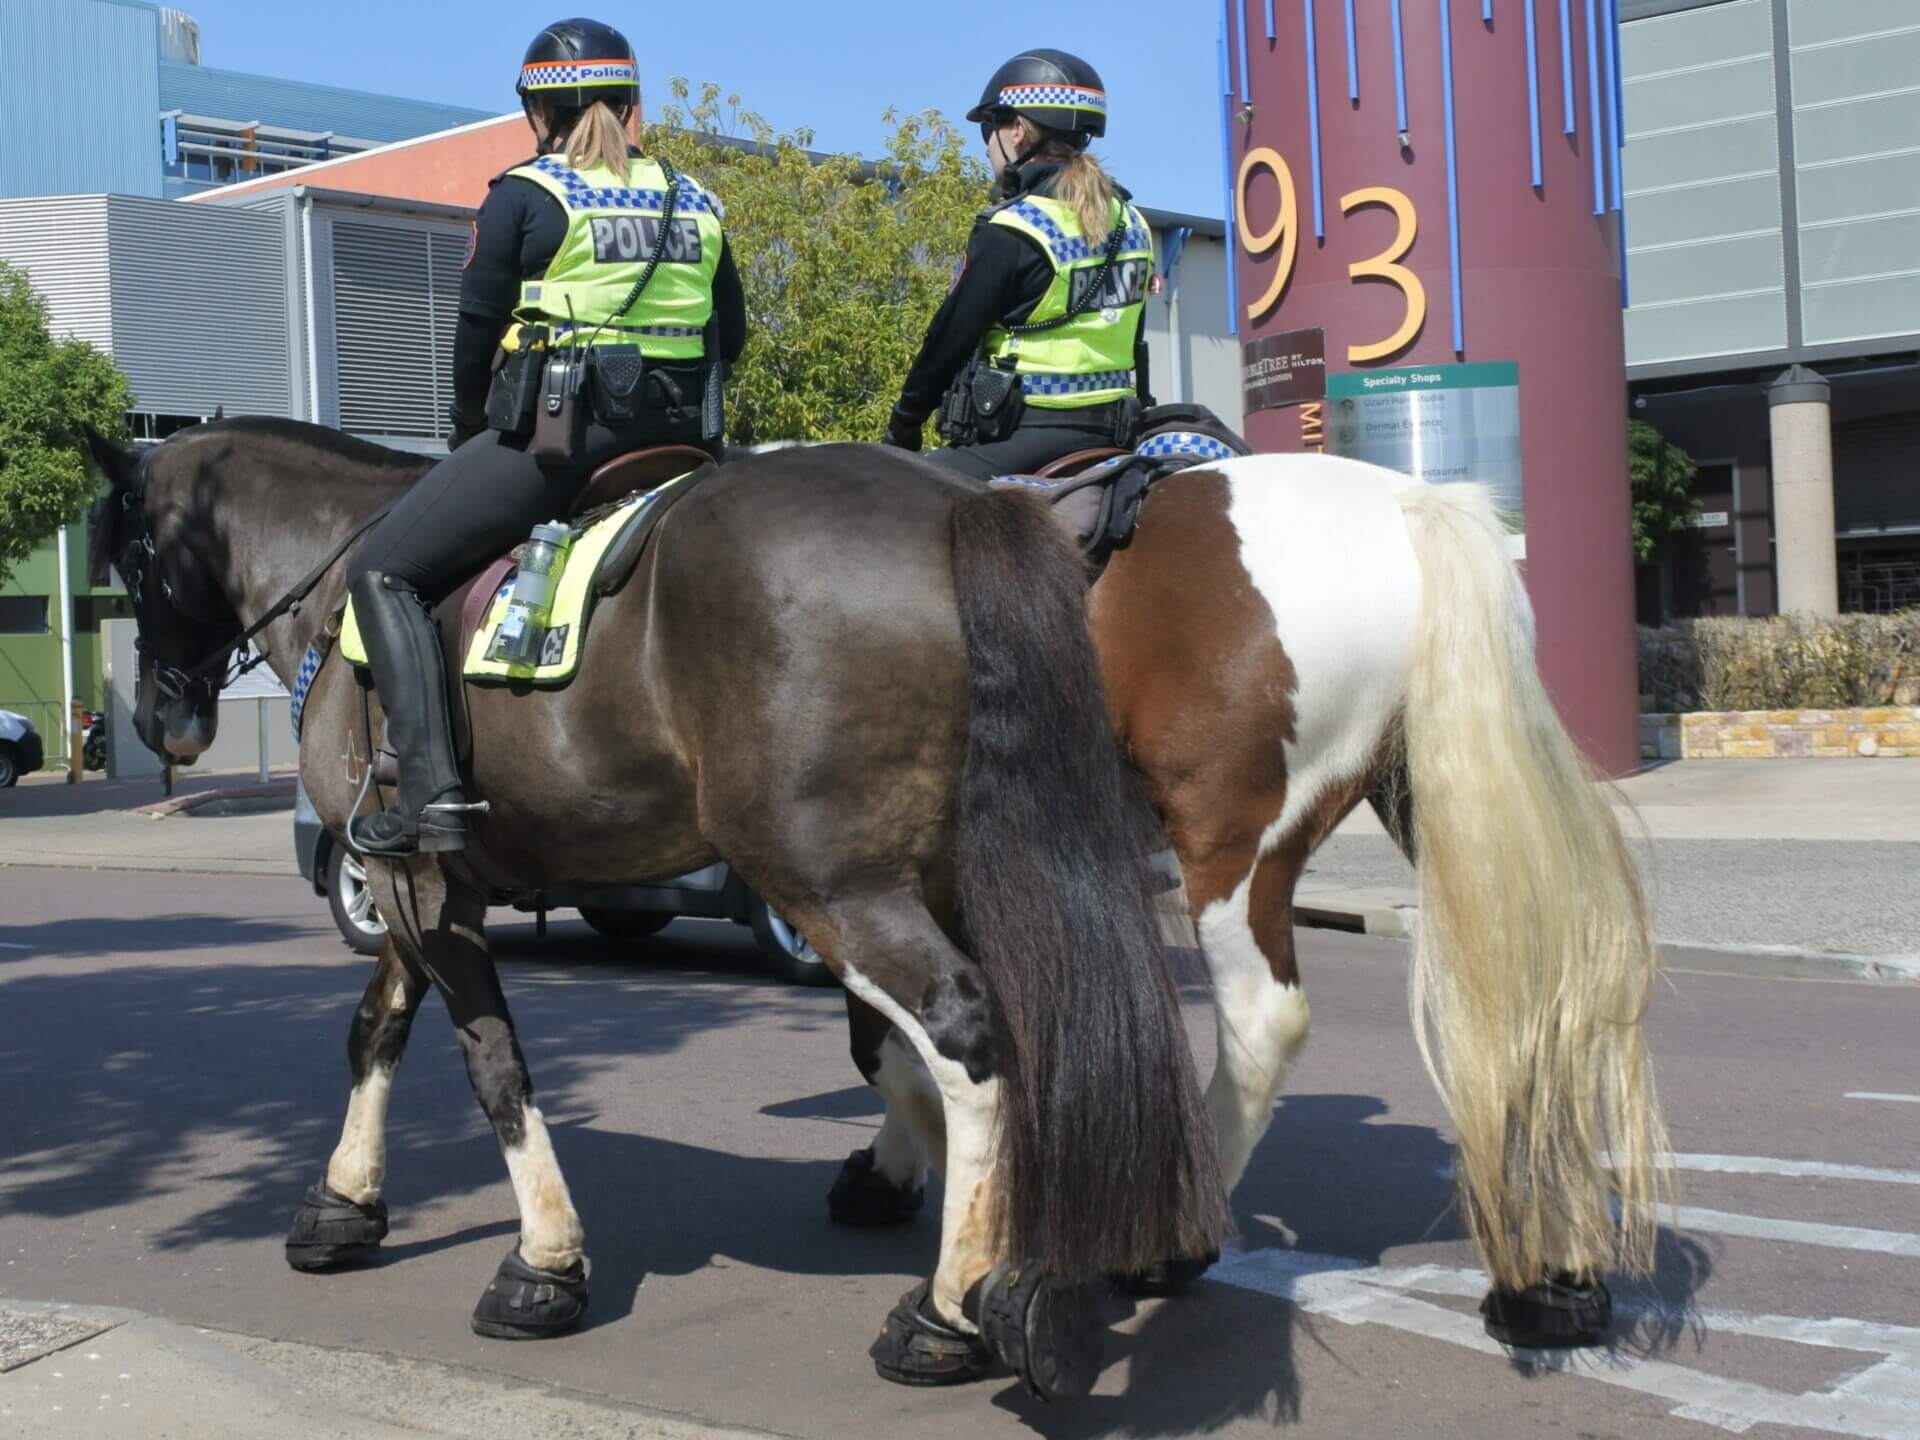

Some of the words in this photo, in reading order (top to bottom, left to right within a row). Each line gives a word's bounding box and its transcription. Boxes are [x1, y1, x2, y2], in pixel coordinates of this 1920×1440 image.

[581, 67, 632, 78] Police
[592, 217, 701, 260] POLICE
[1362, 373, 1407, 388] Specialty
[1410, 372, 1442, 383] Shops
[1420, 465, 1469, 477] estaurant
